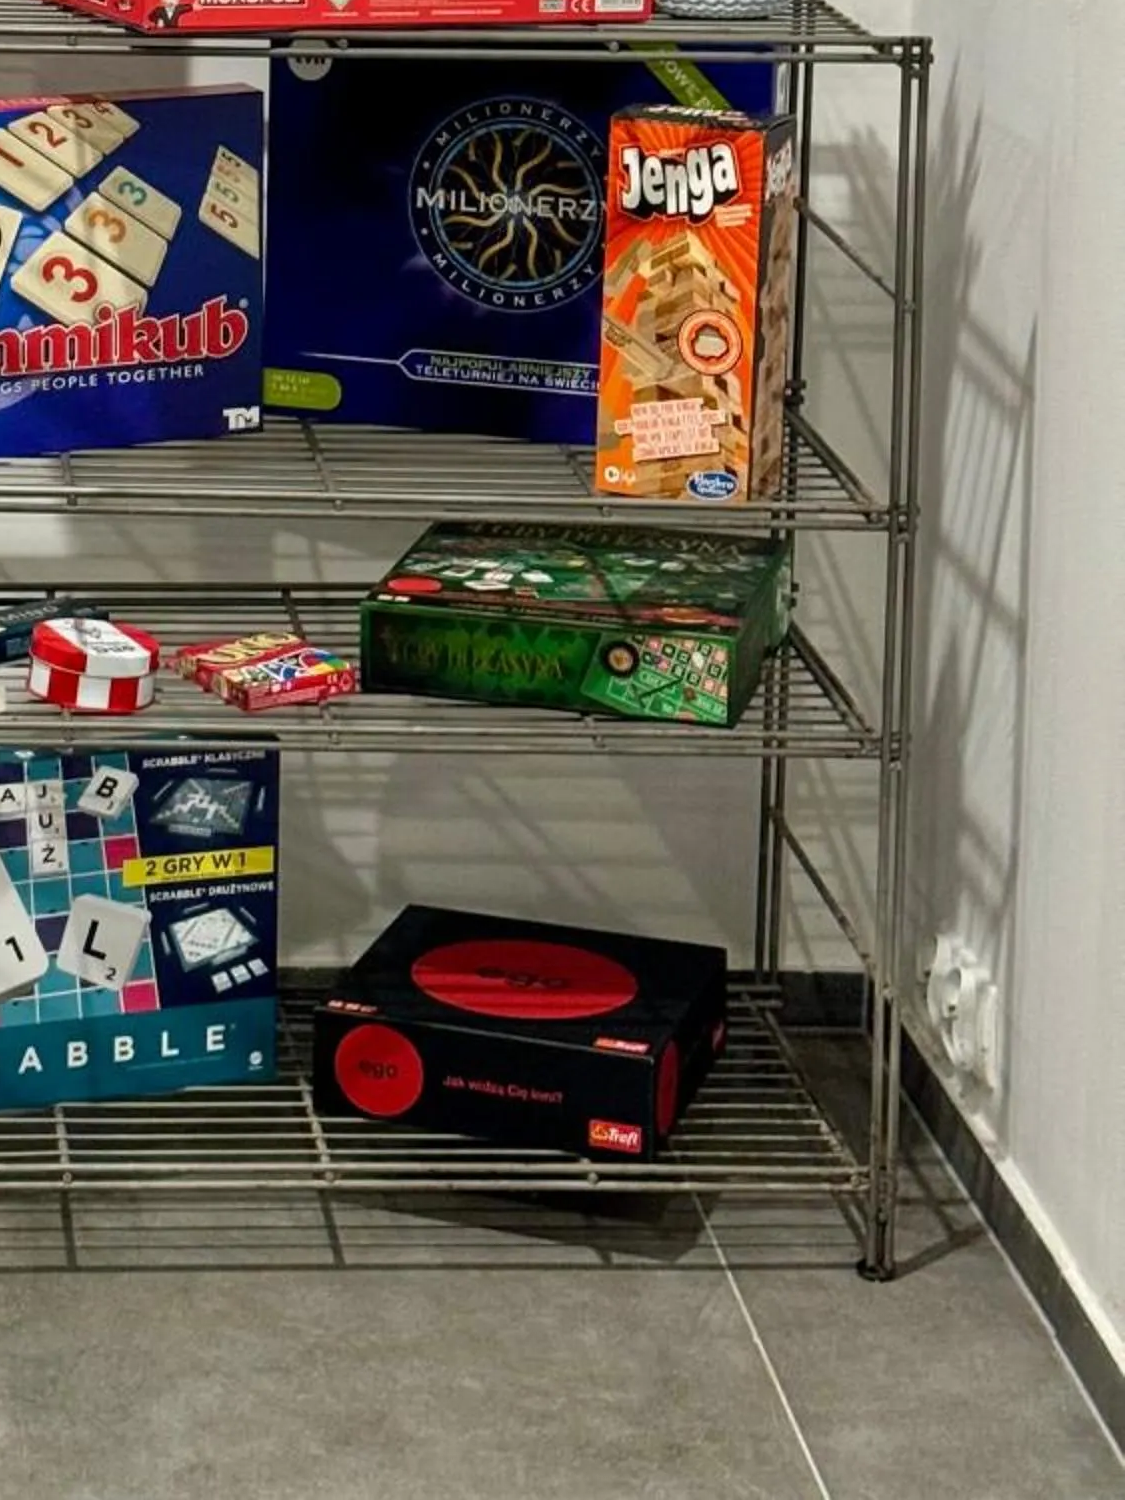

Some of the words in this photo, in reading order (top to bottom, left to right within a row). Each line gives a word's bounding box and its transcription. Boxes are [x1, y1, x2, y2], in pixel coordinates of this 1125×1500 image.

[62, 108, 94, 129] 3
[434, 102, 604, 159] MILIONERZY
[28, 121, 67, 148] 2
[622, 143, 738, 216] Jenga
[118, 181, 148, 206] 3
[88, 210, 127, 244] 3
[210, 202, 239, 229] 5
[41, 255, 99, 303] 3
[432, 252, 597, 308] MILIONERZY
[31, 374, 99, 391] PEOPLE
[108, 364, 205, 385] TOGETHER
[415, 364, 514, 384] TELETURNIEJ
[520, 373, 539, 386] NA
[544, 376, 601, 392] ŚWIECI
[430, 355, 592, 379] NAJPOPULARNIEJSZY
[223, 405, 261, 430] TM
[142, 754, 202, 770] SCRABBLE
[95, 775, 118, 798] B
[145, 859, 157, 877] 2
[163, 855, 206, 875] GRY
[211, 854, 233, 870] W
[238, 852, 247, 868] 1
[149, 888, 205, 903] SCRABBLE
[4, 935, 24, 963] 1
[82, 919, 107, 961] L
[105, 966, 117, 982] 2
[442, 1075, 465, 1088] Jak
[607, 1127, 640, 1147] Trefl
